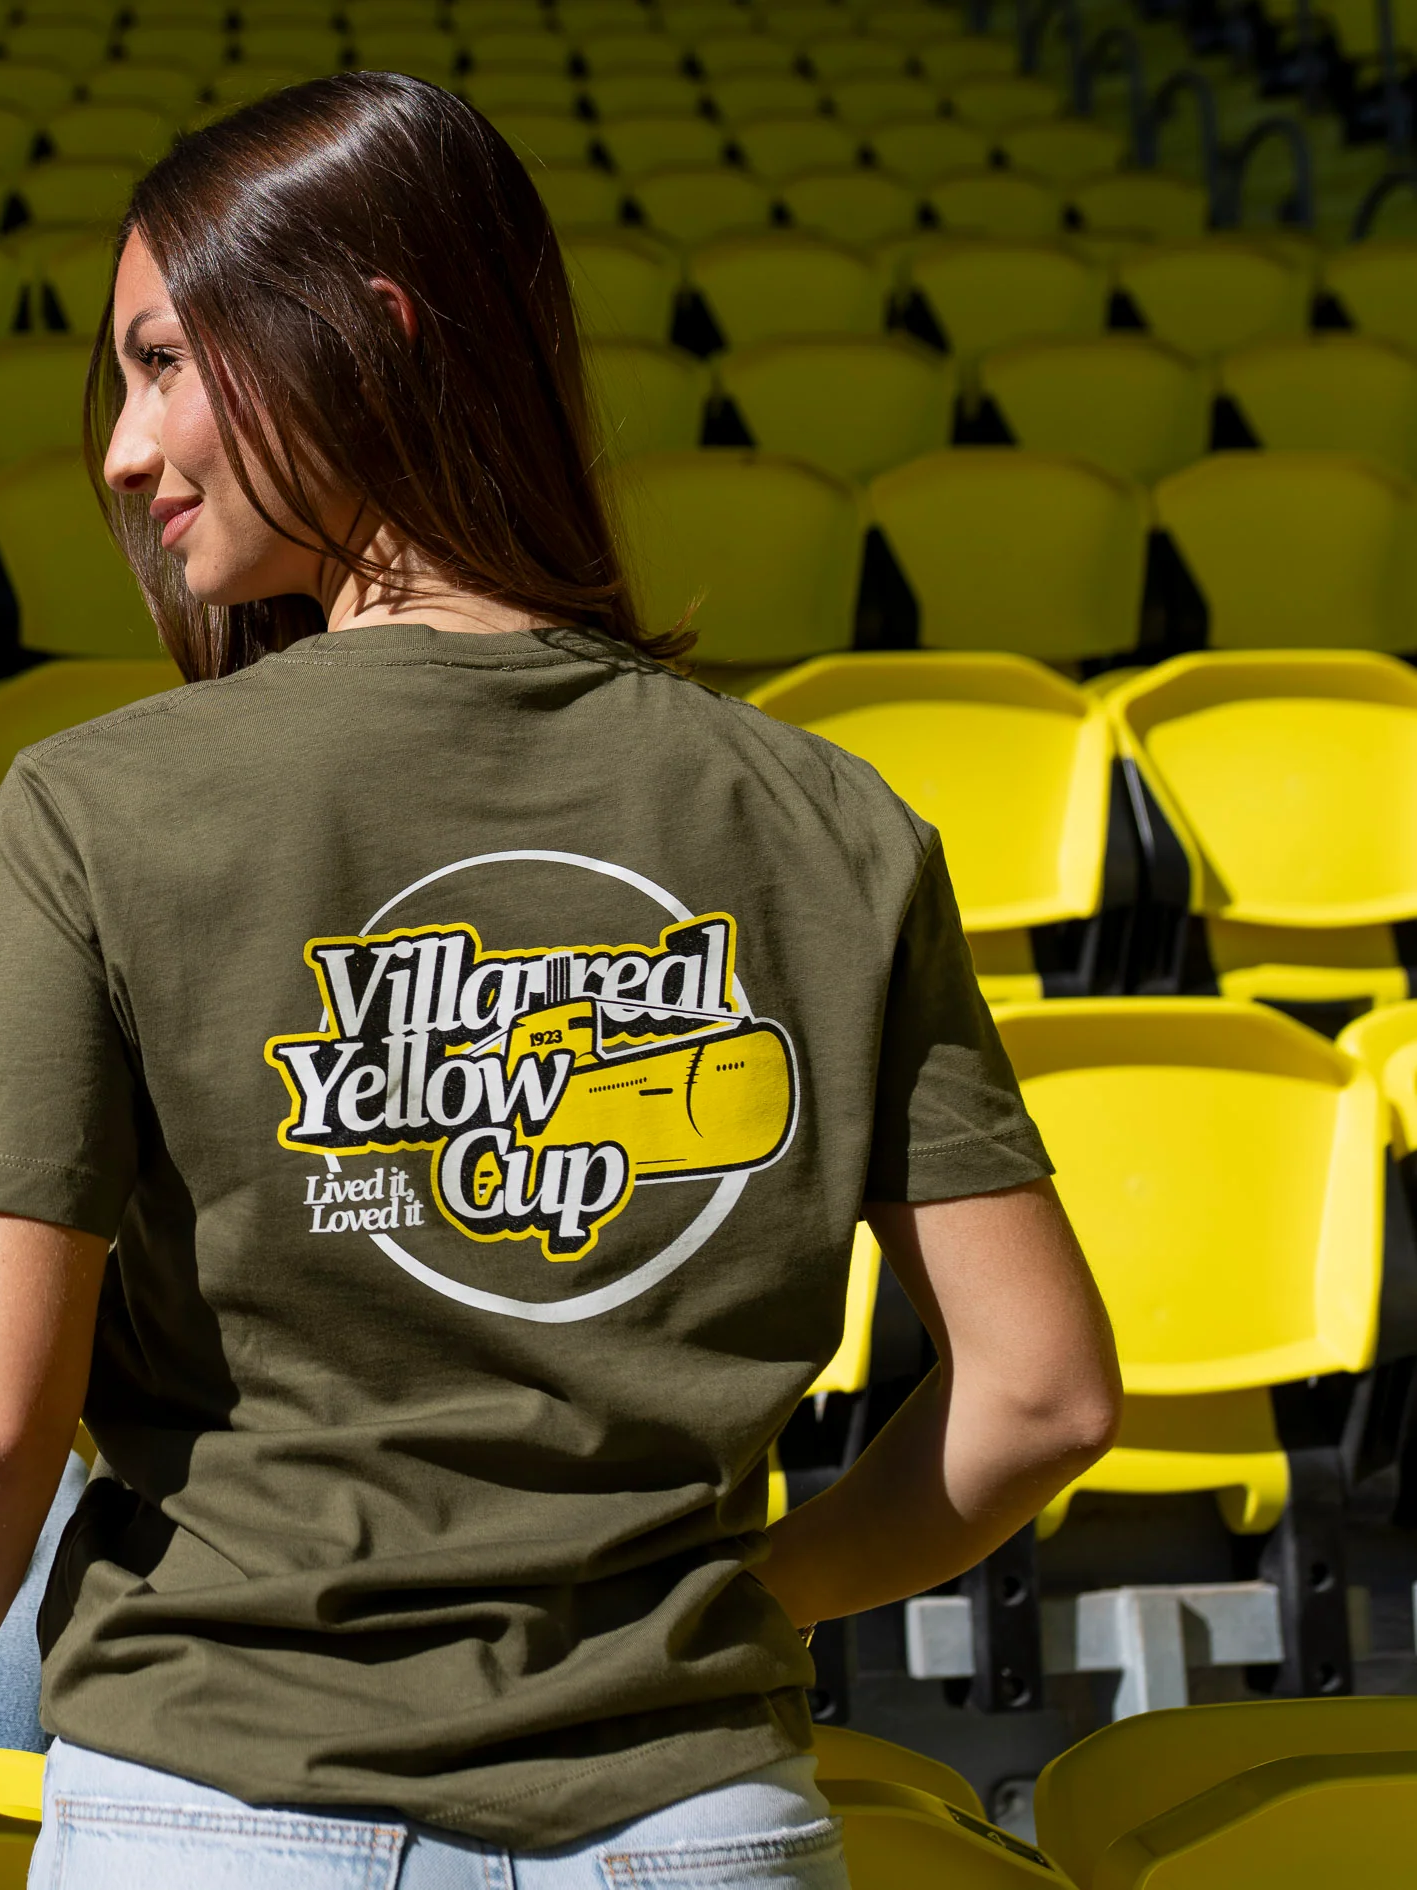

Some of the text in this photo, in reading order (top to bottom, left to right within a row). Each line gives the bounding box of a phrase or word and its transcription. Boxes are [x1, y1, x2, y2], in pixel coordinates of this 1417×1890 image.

[316, 922, 735, 1038] Villarreal
[529, 1029, 563, 1047] 1923
[278, 1031, 571, 1136] Yellow
[303, 1166, 415, 1205] Lived it,
[309, 1197, 425, 1233] Loved it
[441, 1126, 624, 1237] Cup
